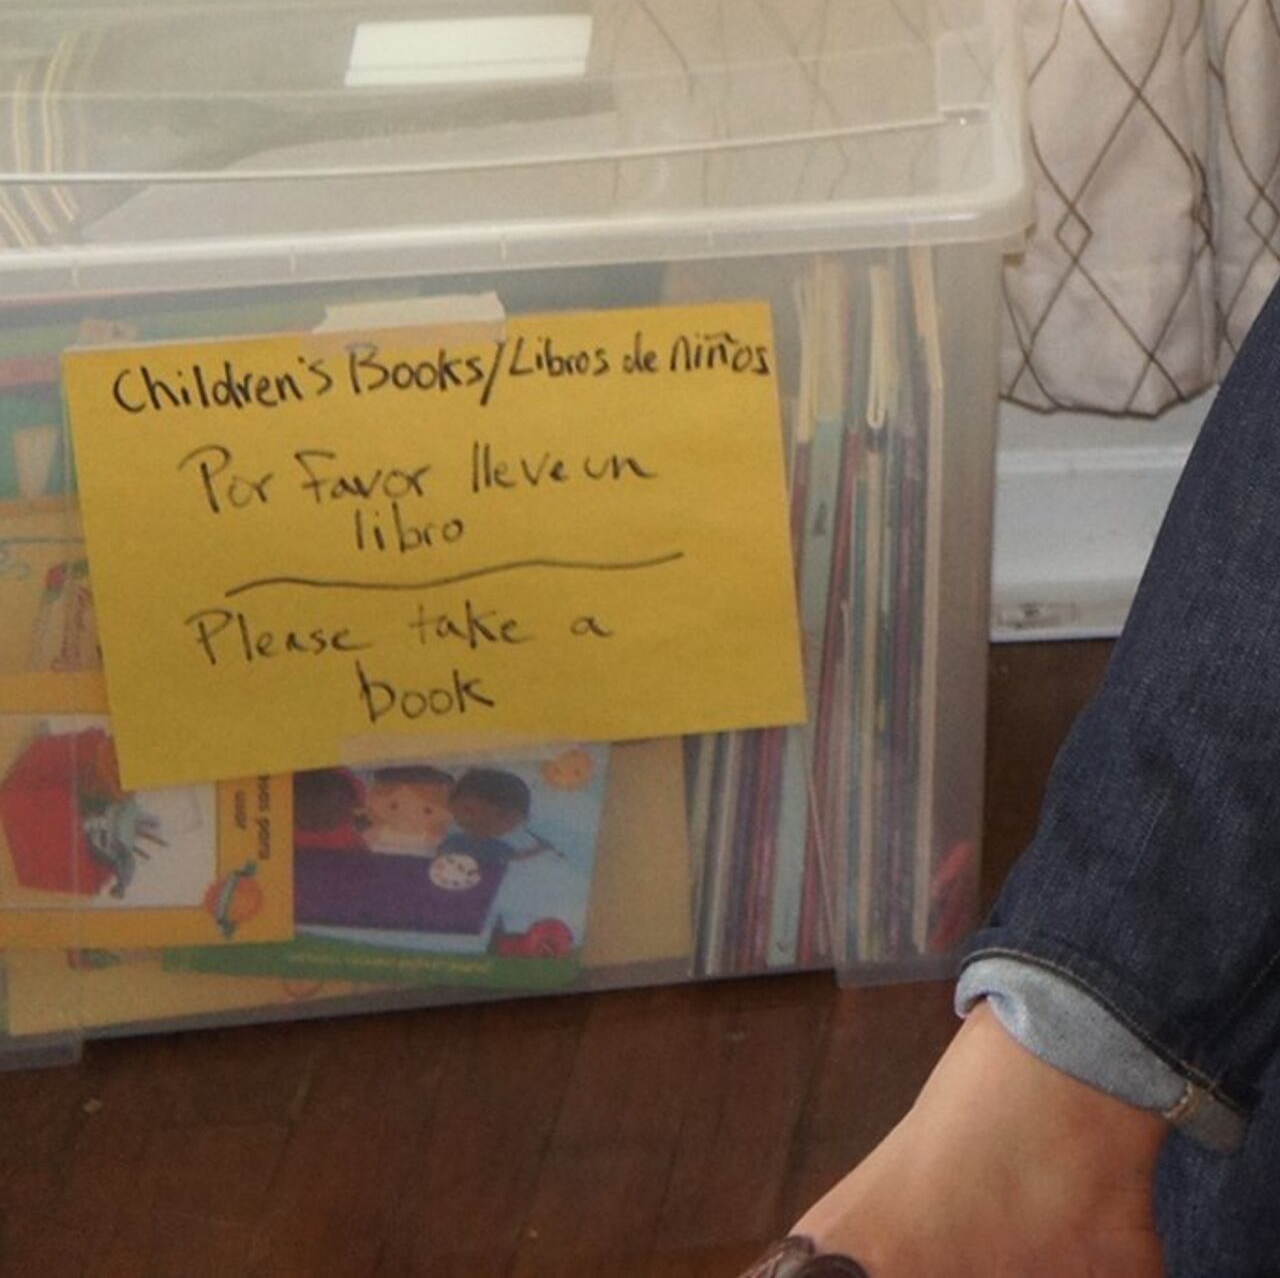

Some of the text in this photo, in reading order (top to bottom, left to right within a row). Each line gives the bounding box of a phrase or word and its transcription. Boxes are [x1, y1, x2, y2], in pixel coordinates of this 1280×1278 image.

[112, 354, 334, 414] Children's
[623, 330, 658, 374] de
[178, 444, 273, 514] Por
[354, 503, 465, 553] libro
[184, 601, 615, 666] Please take a
[355, 659, 496, 724] book
